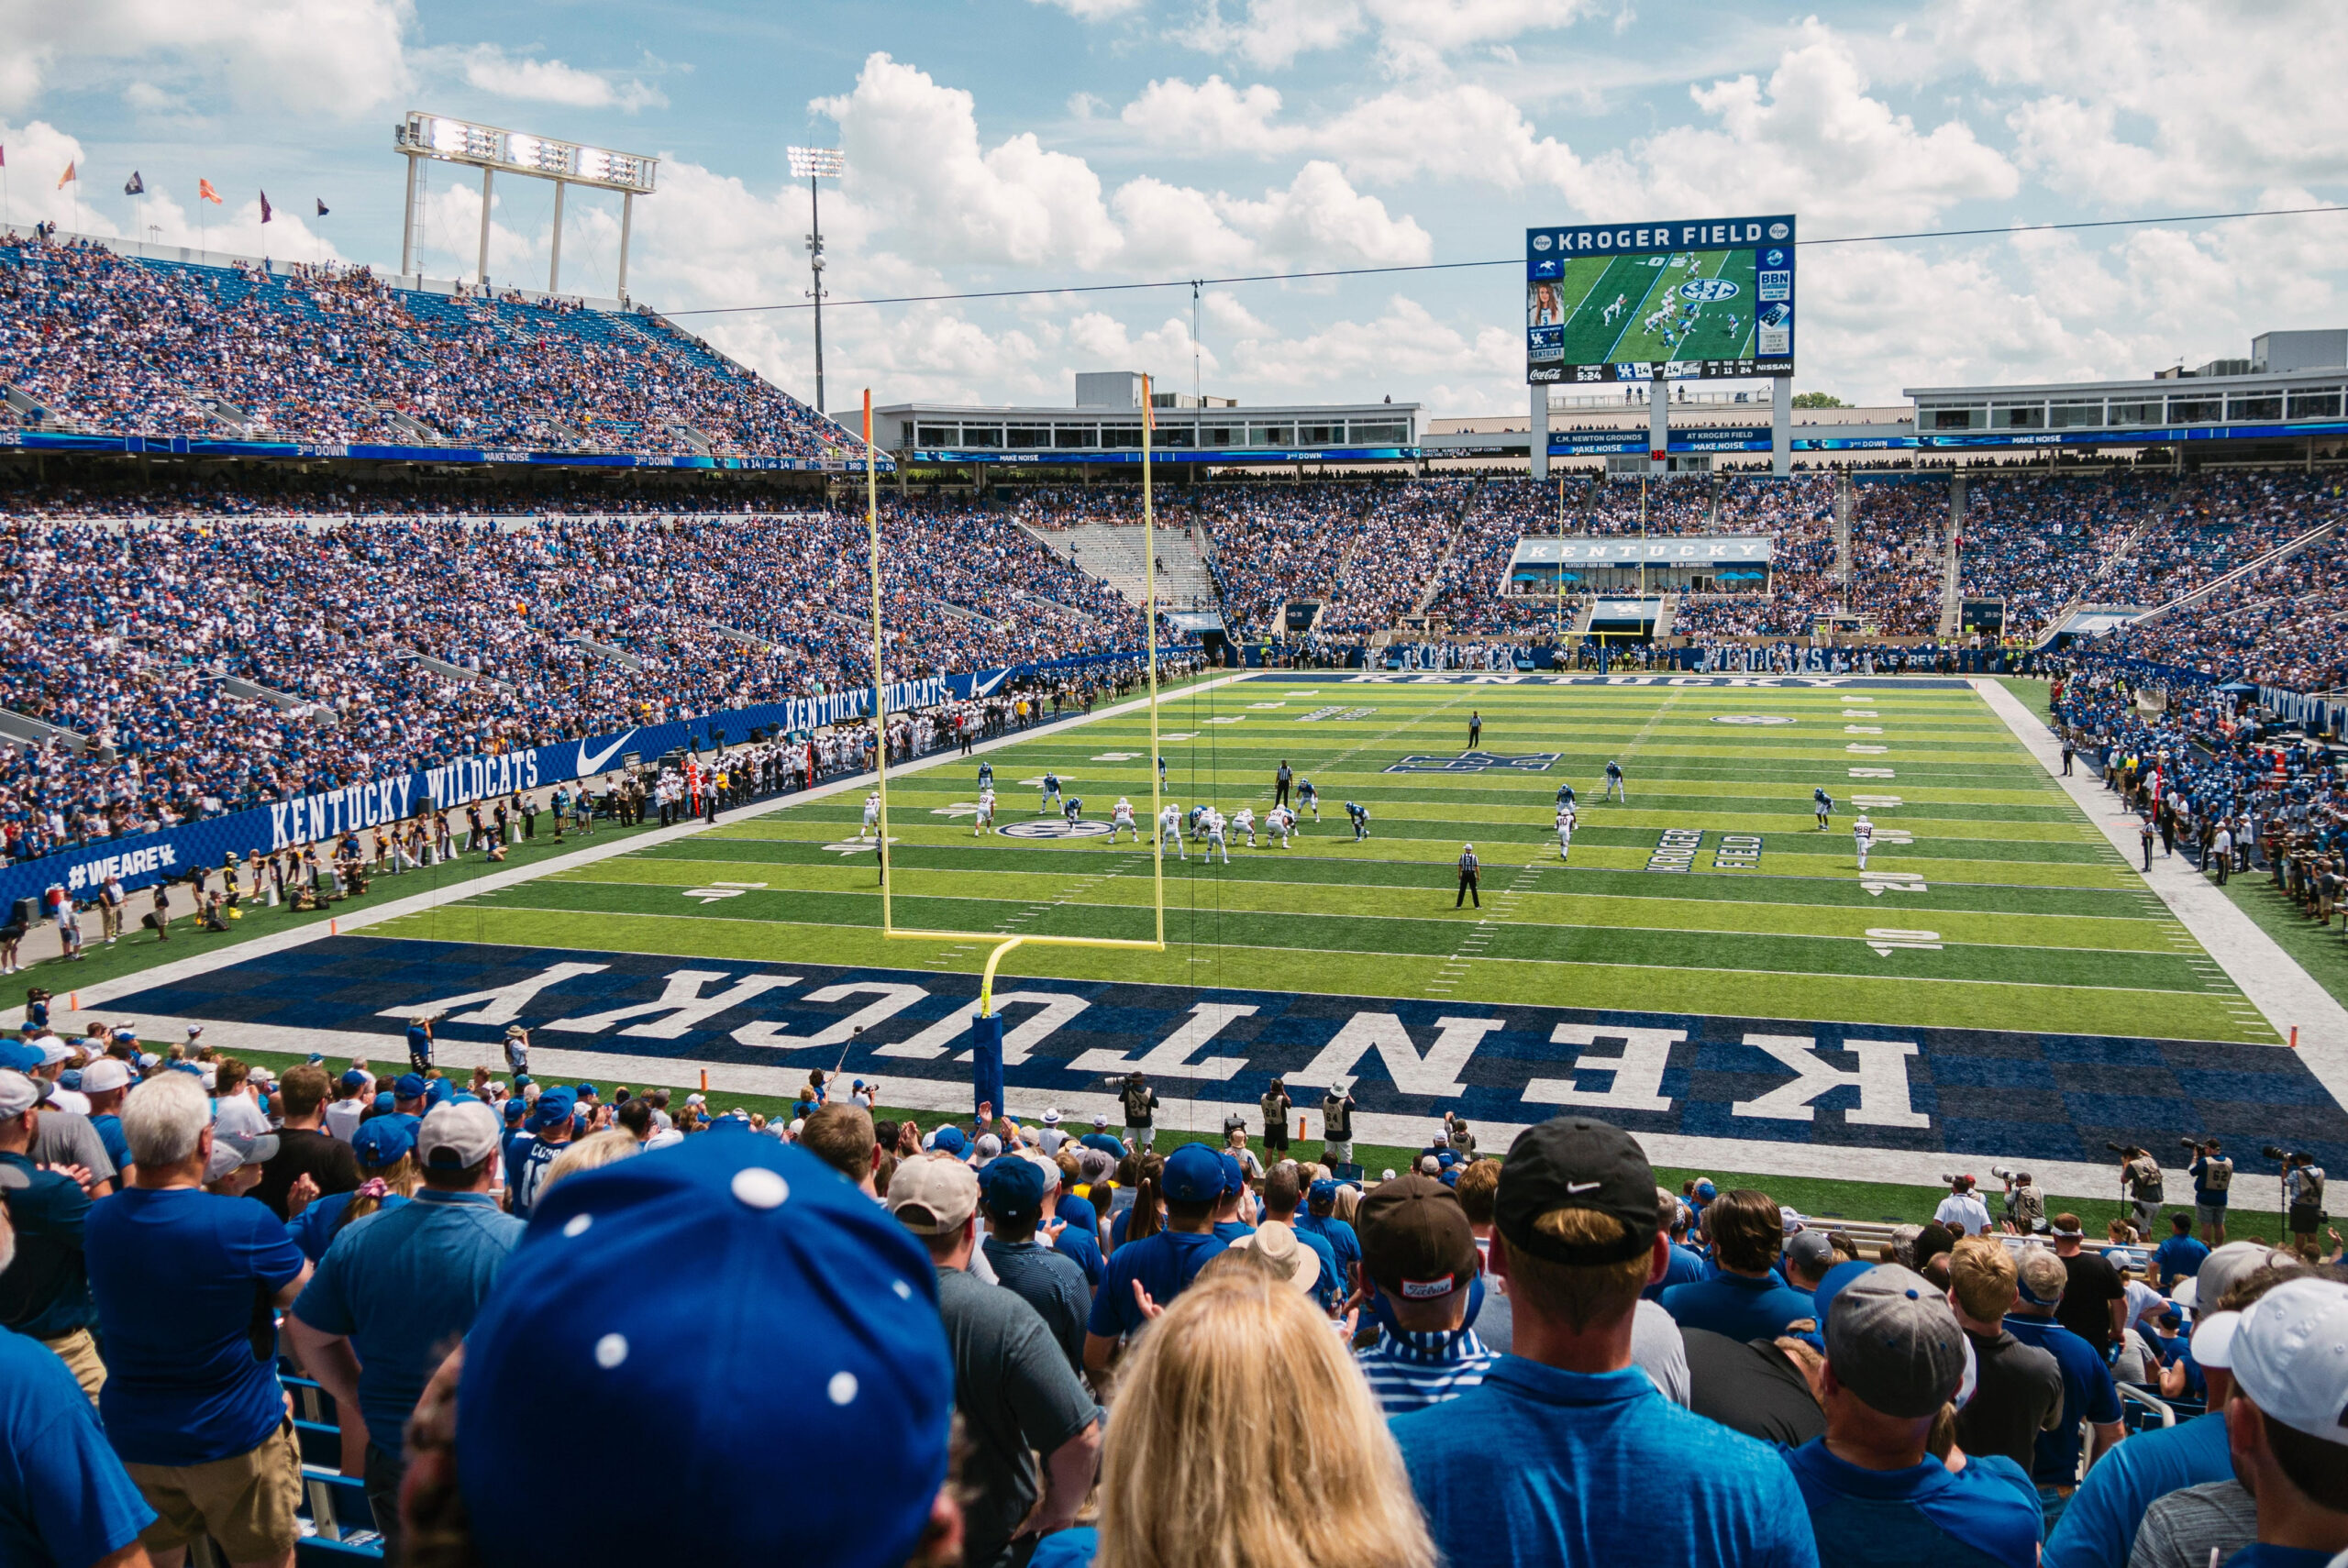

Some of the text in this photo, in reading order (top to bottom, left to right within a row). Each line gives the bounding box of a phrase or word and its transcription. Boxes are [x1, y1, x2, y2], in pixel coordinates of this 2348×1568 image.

[1559, 223, 1762, 250] KROGER FIELD
[1761, 273, 1789, 283] BBN
[1578, 371, 1601, 381] 5:24
[1556, 433, 1643, 443] C.M. NEWTON GROUNDS
[2035, 435, 2062, 443] NOISE
[315, 445, 349, 456] DOWN
[1572, 444, 1622, 453] MAKE NOISE
[483, 453, 530, 462] MAKE NOISE
[1652, 450, 1665, 459] 35
[648, 457, 674, 466] DOWN
[751, 459, 760, 469] 14
[781, 460, 790, 469] 14
[848, 462, 862, 470] 3RD
[1529, 545, 1757, 557] KENTUCKY
[1342, 675, 1852, 688] KENTUCKY
[786, 689, 869, 733] KENTUCKY
[426, 748, 538, 810] WILDCATS
[271, 774, 412, 850] KENTUCKY
[1645, 829, 1763, 872] KROGER FIELD
[375, 962, 1933, 1130] KENTUCKY
[1326, 1112, 1337, 1123] 64
[2213, 1169, 2228, 1181] 62
